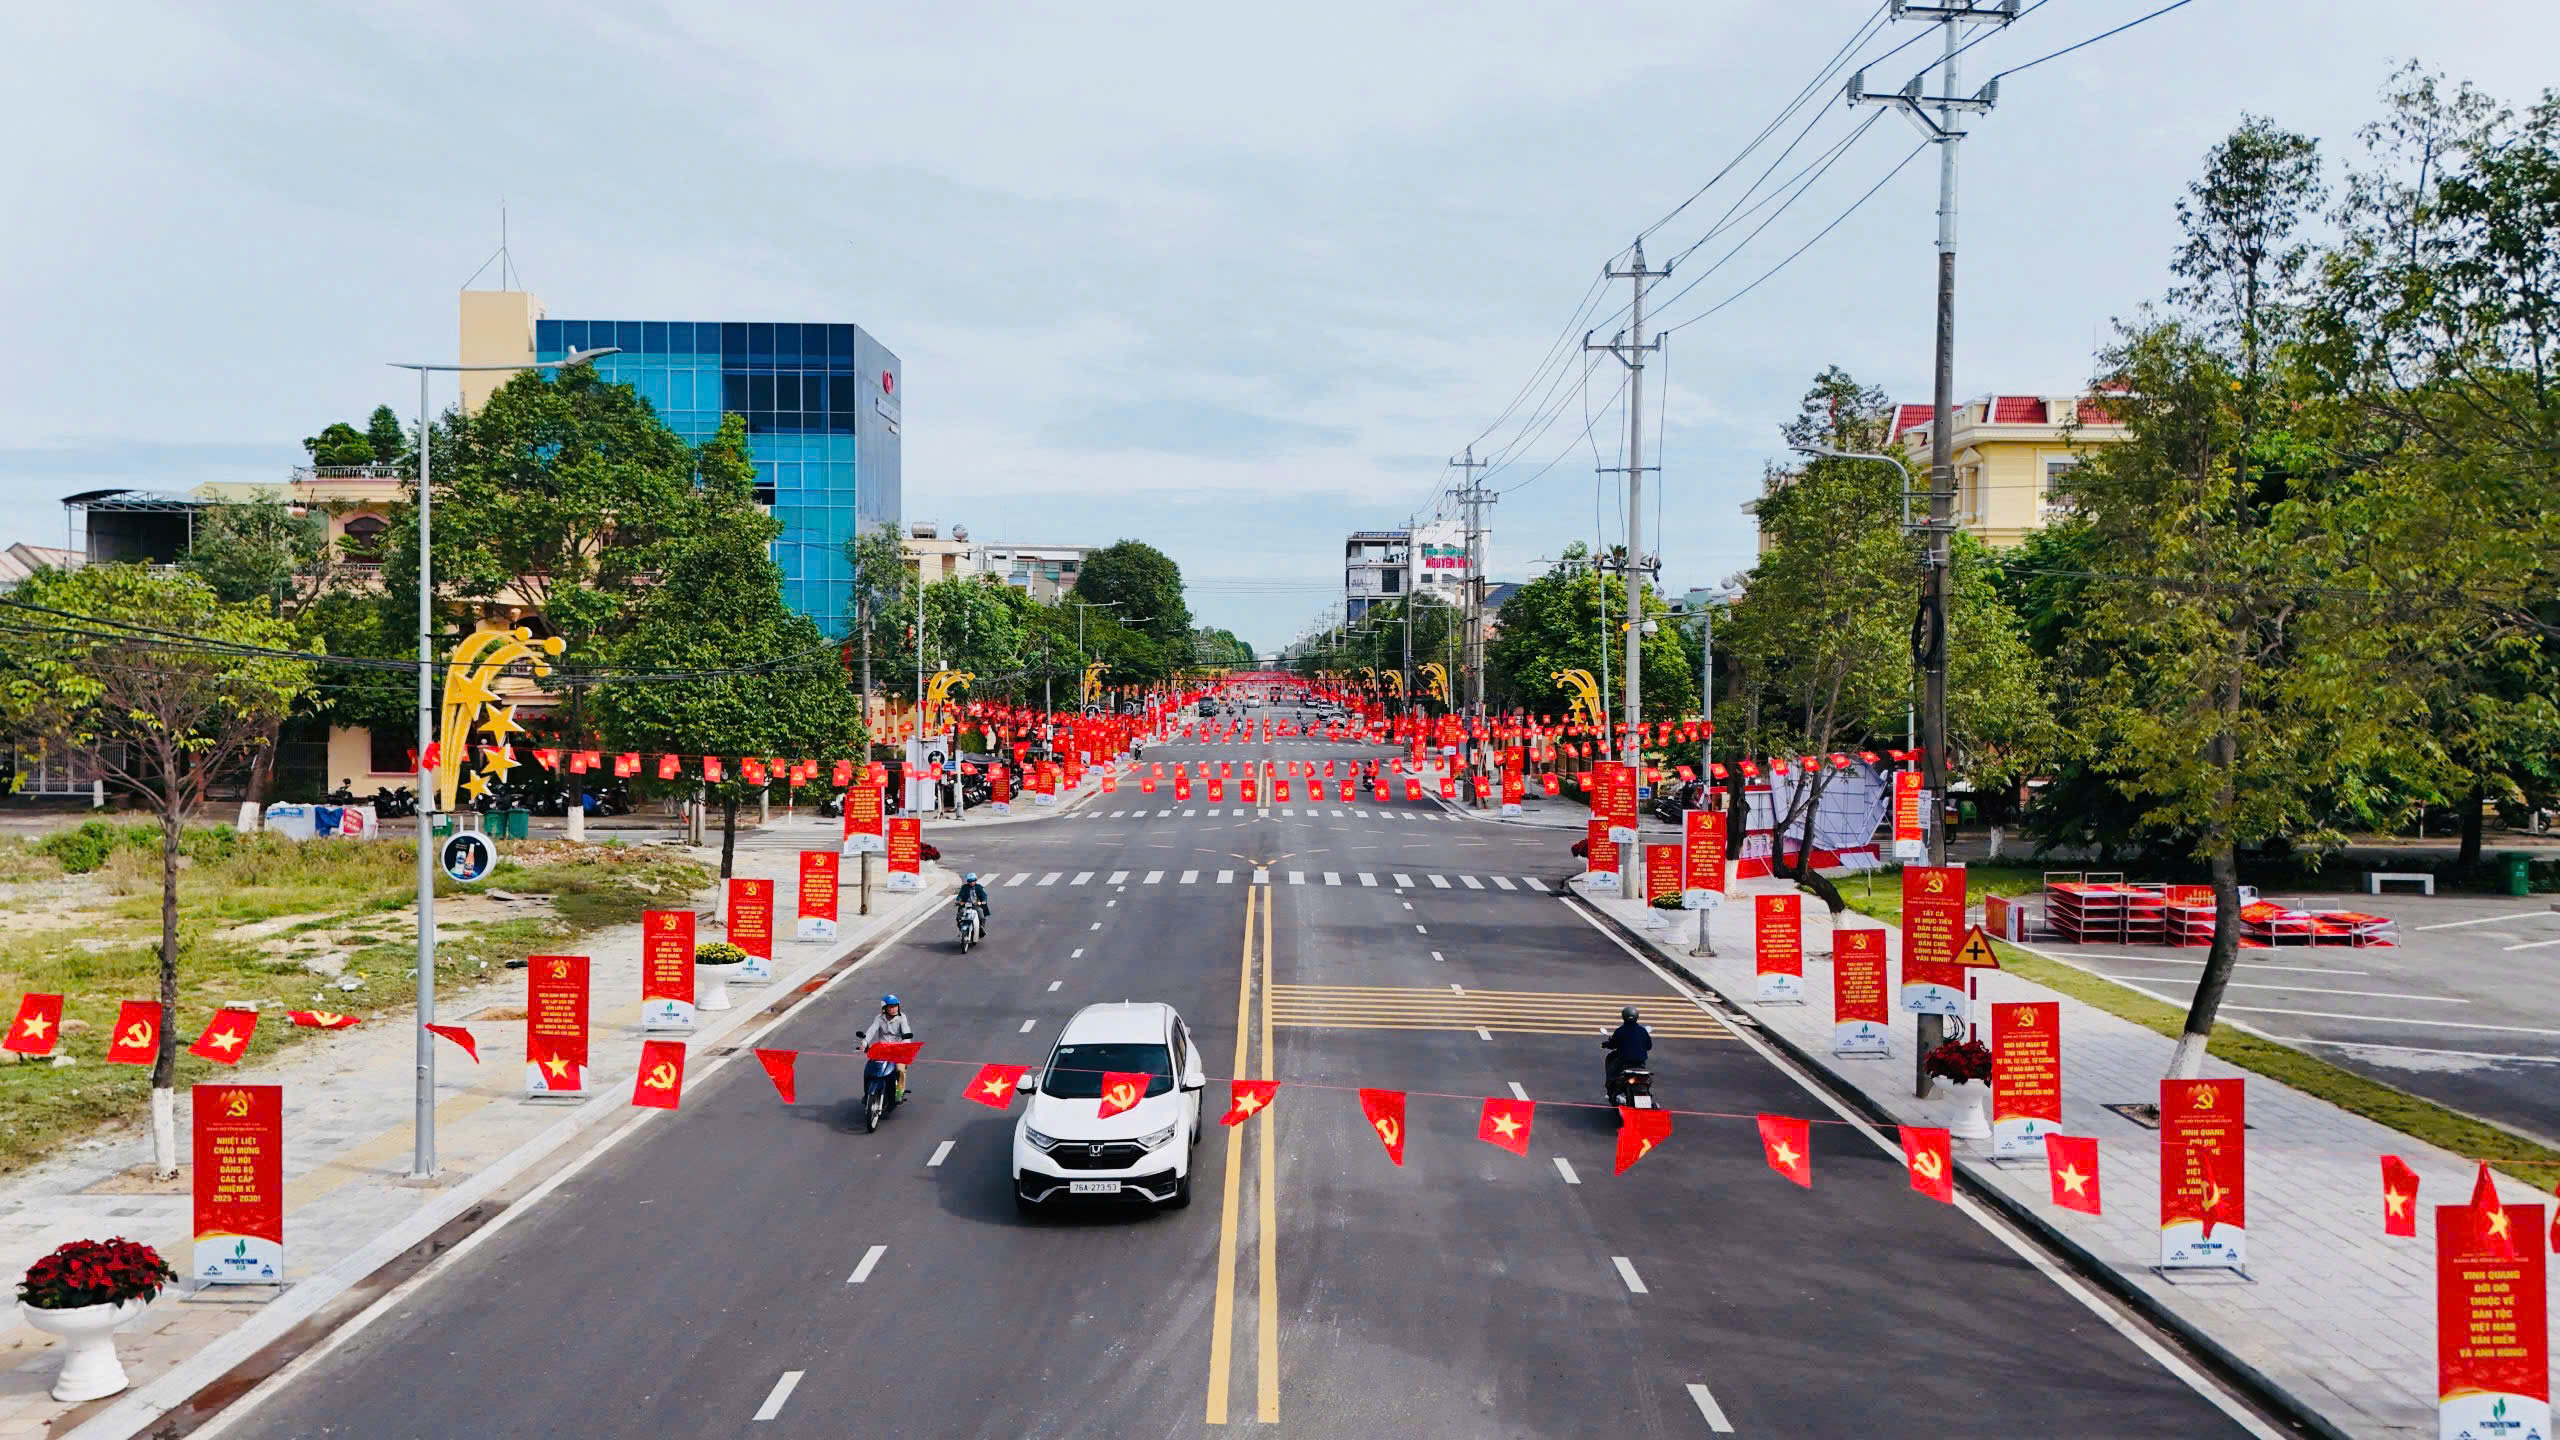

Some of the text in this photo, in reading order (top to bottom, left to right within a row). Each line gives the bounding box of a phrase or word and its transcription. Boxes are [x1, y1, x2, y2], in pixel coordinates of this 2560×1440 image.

[216, 1136, 256, 1145] NHIỆT LIỆT
[214, 1146, 260, 1154] CHÀO MỪNG
[223, 1156, 251, 1165] ĐẠI HỘI
[220, 1165, 254, 1174] ĐẢNG BỘ
[221, 1174, 254, 1183] CÁC CẤP
[219, 1184, 243, 1193] NHIỆM
[2463, 1270, 2520, 1280] VINH QUANG
[2474, 1282, 2510, 1293] ĐỜI ĐỜI
[2470, 1295, 2515, 1306] THUỘC VỀ
[2472, 1308, 2512, 1319] DÂN TỘC
[2470, 1322, 2516, 1333] VIỆT NAM
[2471, 1335, 2491, 1344] VĂN
[2459, 1347, 2528, 1357] VÀ ANH HÙNG!
